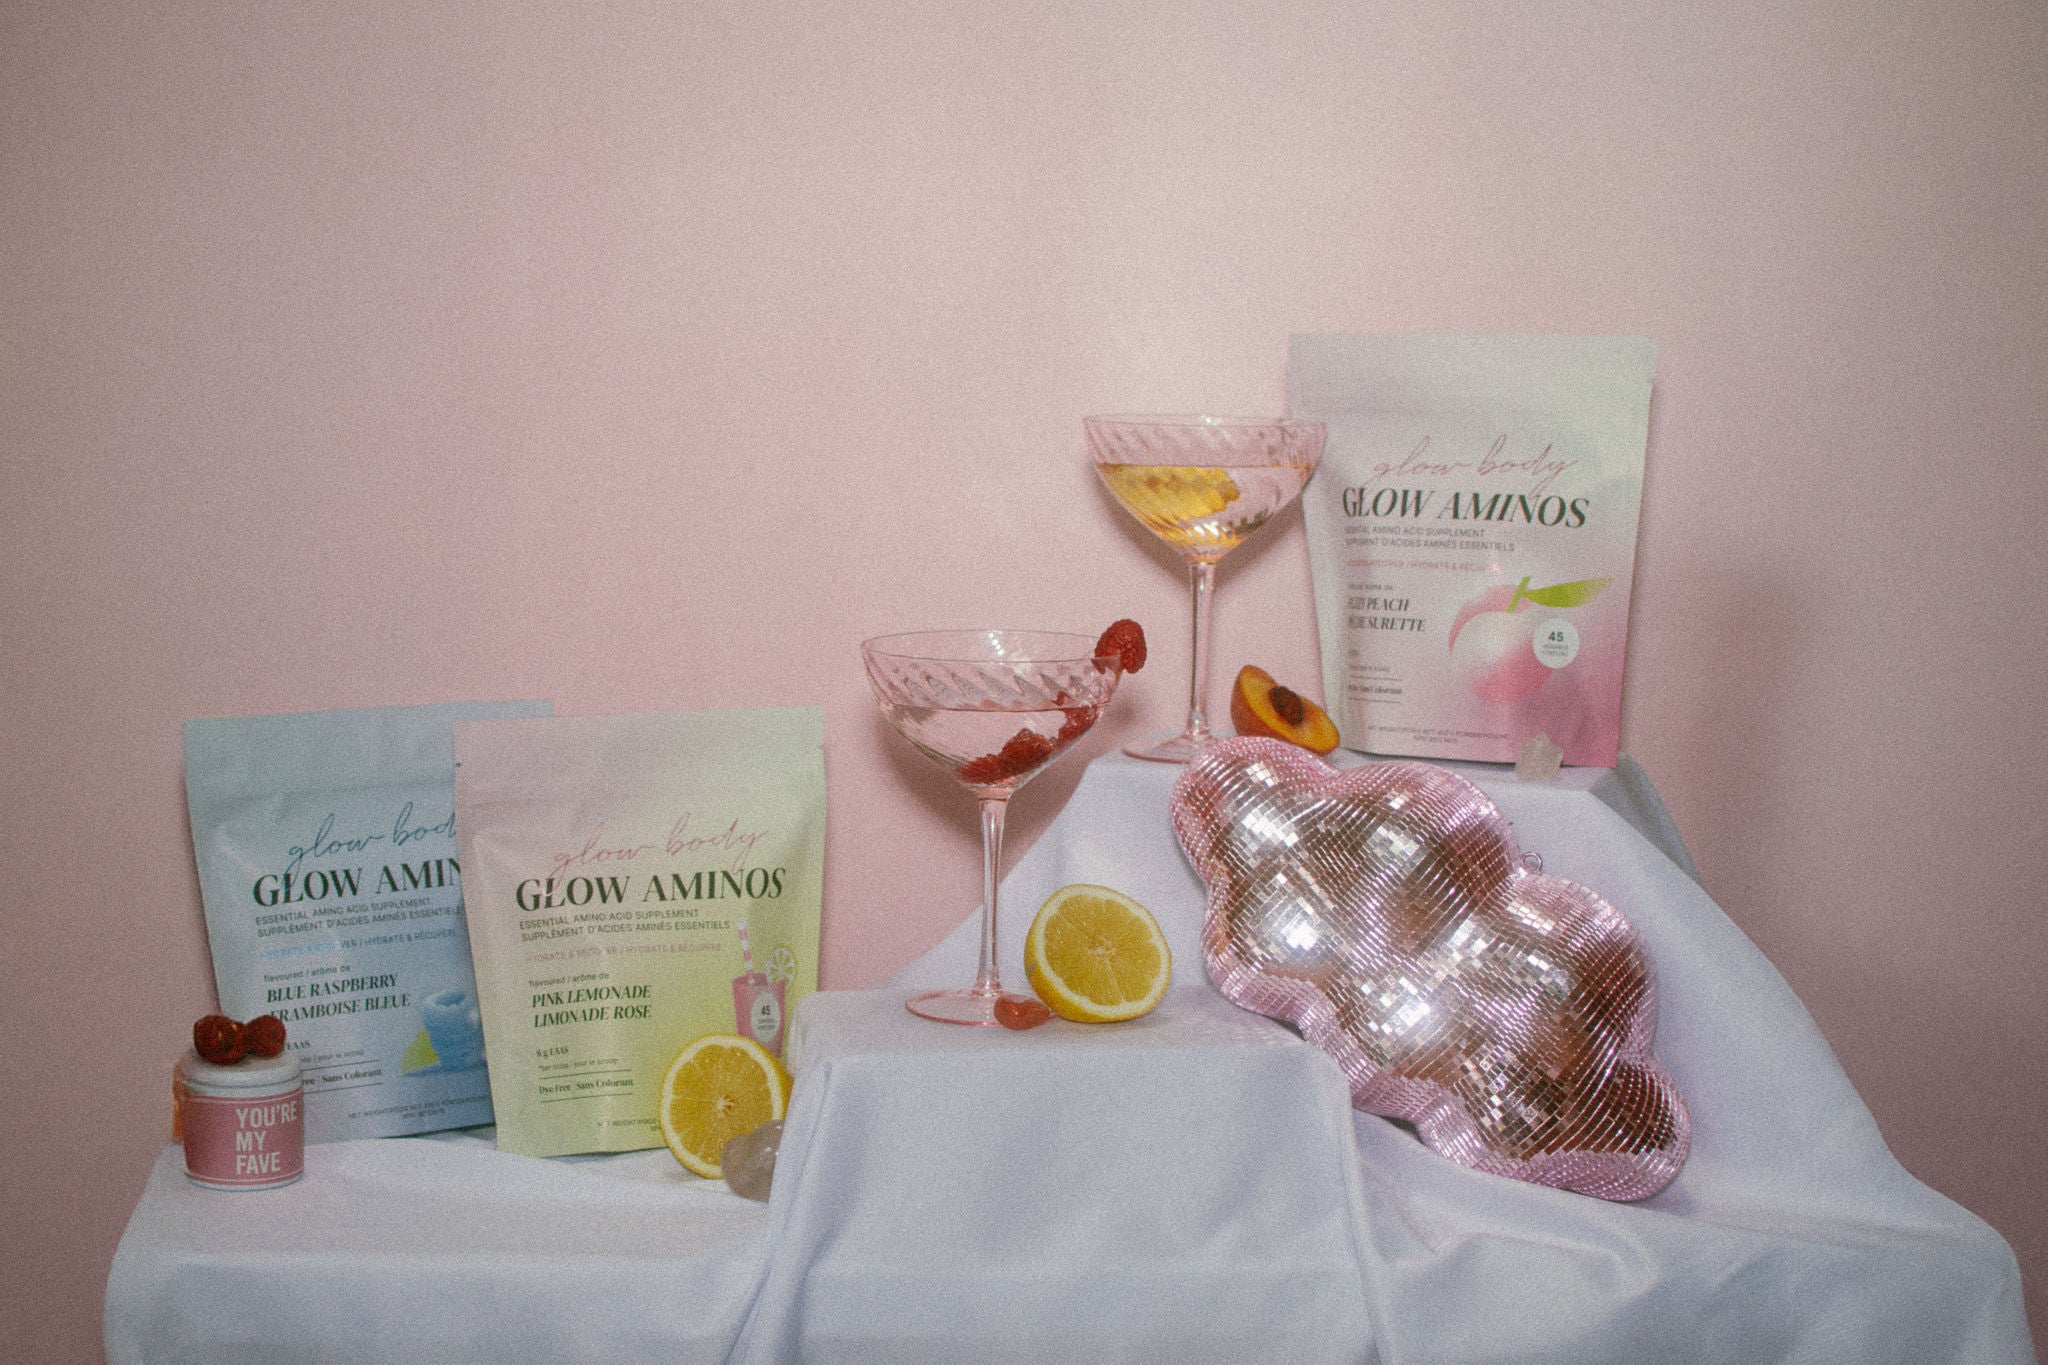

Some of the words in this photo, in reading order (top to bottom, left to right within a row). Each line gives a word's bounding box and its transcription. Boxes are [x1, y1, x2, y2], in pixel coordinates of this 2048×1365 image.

[1359, 435, 1473, 493] glow
[1477, 433, 1579, 500] body
[1342, 486, 1436, 519] GLOW
[1437, 491, 1591, 529] AMINOS
[1367, 598, 1410, 612] PEACH
[1548, 631, 1565, 643] 45
[283, 813, 386, 892] glow
[393, 800, 457, 847] bod
[547, 822, 655, 893] glow
[665, 811, 768, 876] body
[252, 867, 363, 907] GLOW
[515, 875, 630, 912] GLOW
[642, 866, 786, 903] AMINOS
[255, 911, 309, 926] ESSENTIAL
[312, 905, 344, 918] AMINO
[346, 903, 369, 915] ACID
[371, 896, 431, 912] SUPPLEMENT
[519, 916, 570, 931] ESSENTIAL
[573, 911, 607, 923] AMINO
[609, 910, 633, 921] ACID
[635, 907, 699, 919] SUPPLEMENT
[674, 919, 730, 932] ESSENTIELS
[263, 970, 304, 983] flavoured
[266, 983, 307, 1005] BLUE
[309, 972, 398, 998] RASPBERRY
[528, 977, 566, 988] flavoured
[364, 993, 412, 1013] BLEUE
[531, 989, 567, 1009] PINK
[567, 984, 652, 1004] LEMONADE
[533, 1006, 610, 1028] LIMONADE
[613, 1004, 652, 1021] ROSE
[761, 1004, 771, 1016] 45
[236, 1101, 298, 1129] YOU'RE
[236, 1131, 267, 1152] MY
[236, 1152, 281, 1175] FAVE
